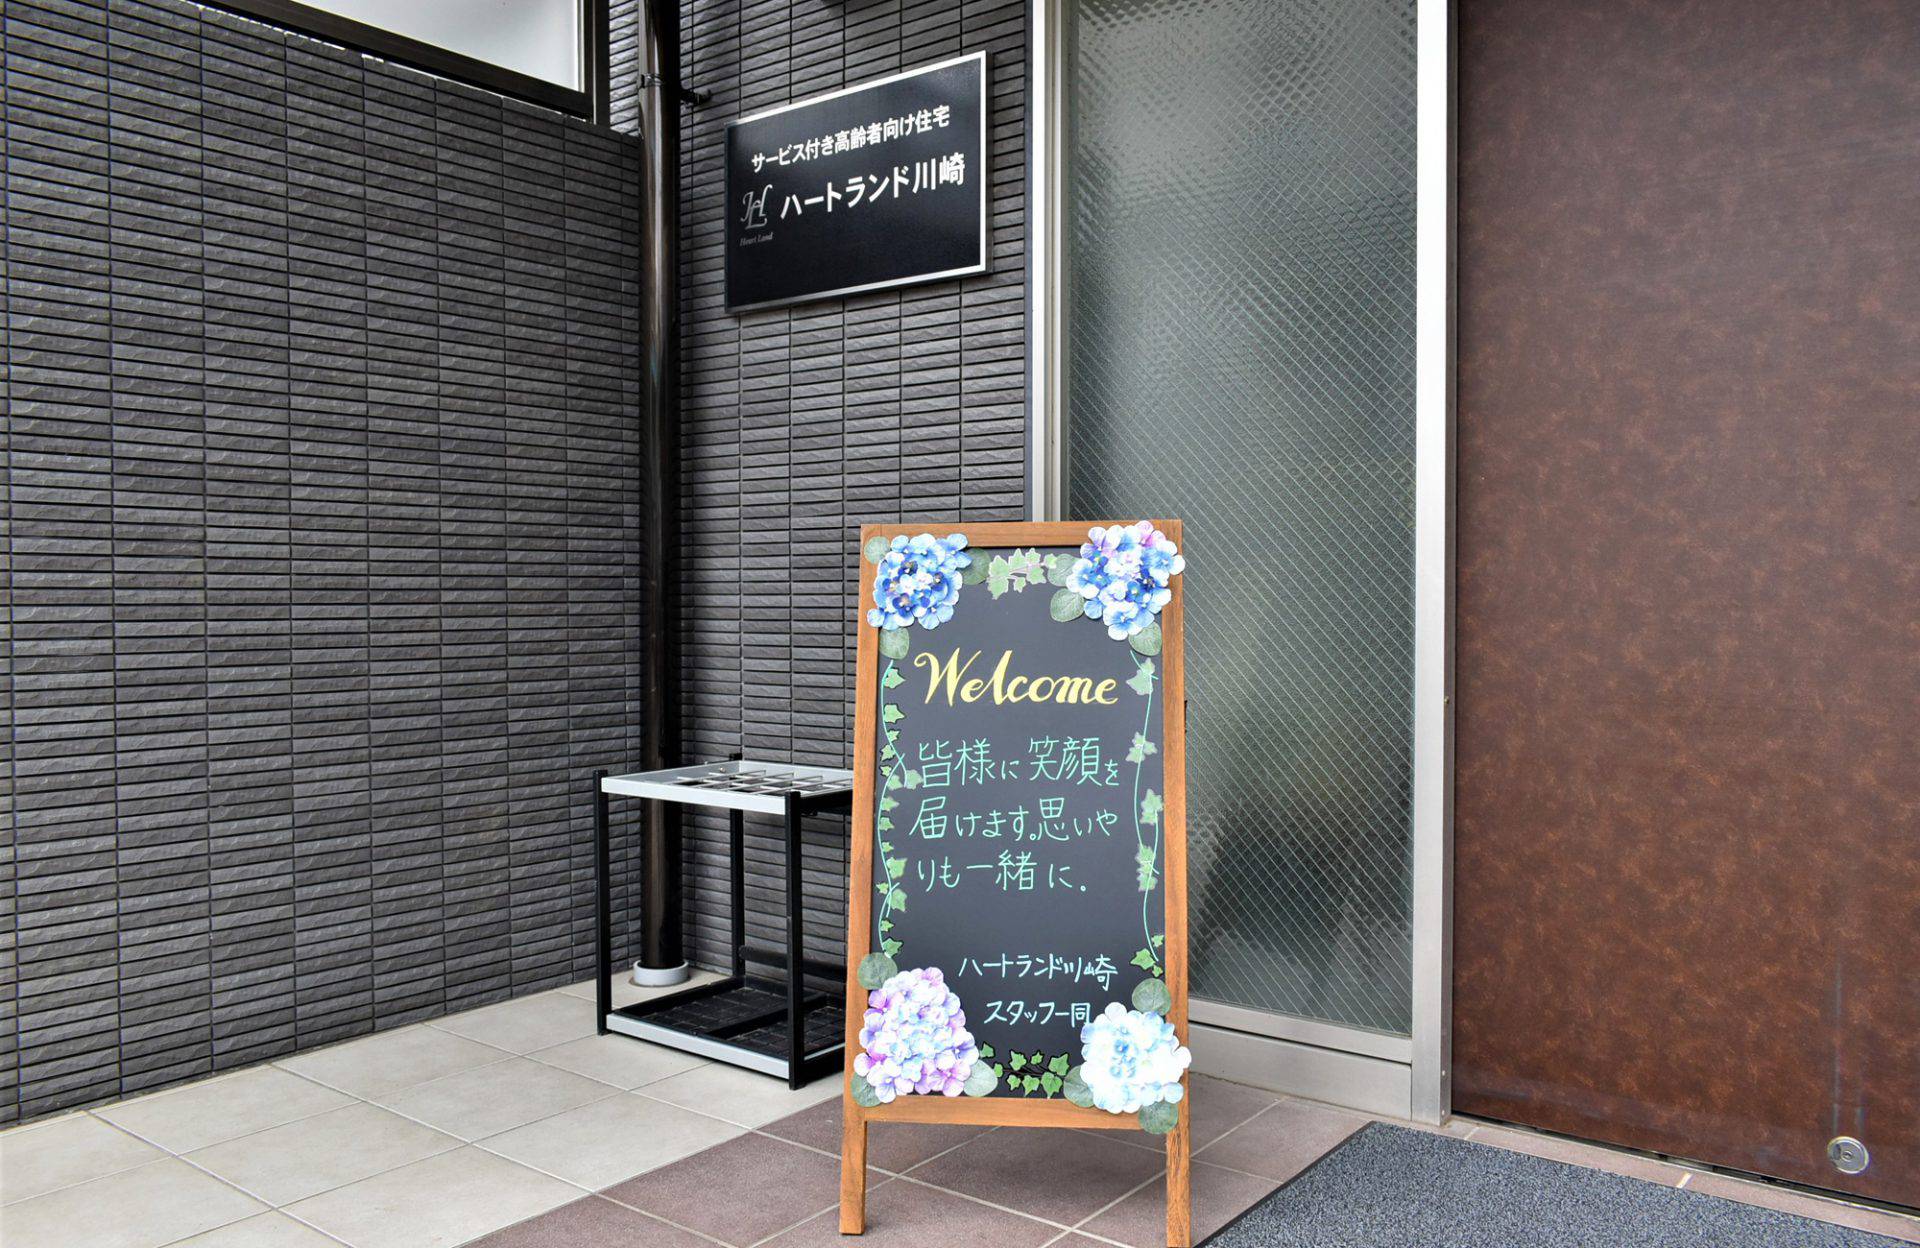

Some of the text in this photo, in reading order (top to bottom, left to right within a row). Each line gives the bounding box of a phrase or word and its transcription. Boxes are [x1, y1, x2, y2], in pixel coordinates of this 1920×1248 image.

[752, 104, 950, 173] サービス付き高齢者向け住宅
[780, 152, 965, 219] ハートランド川崎
[914, 647, 1118, 706] Welcome
[918, 850, 1087, 892] りも一緒に。
[958, 953, 1118, 991] ハートランド川崎
[984, 1000, 1091, 1028] スタッフ一同
